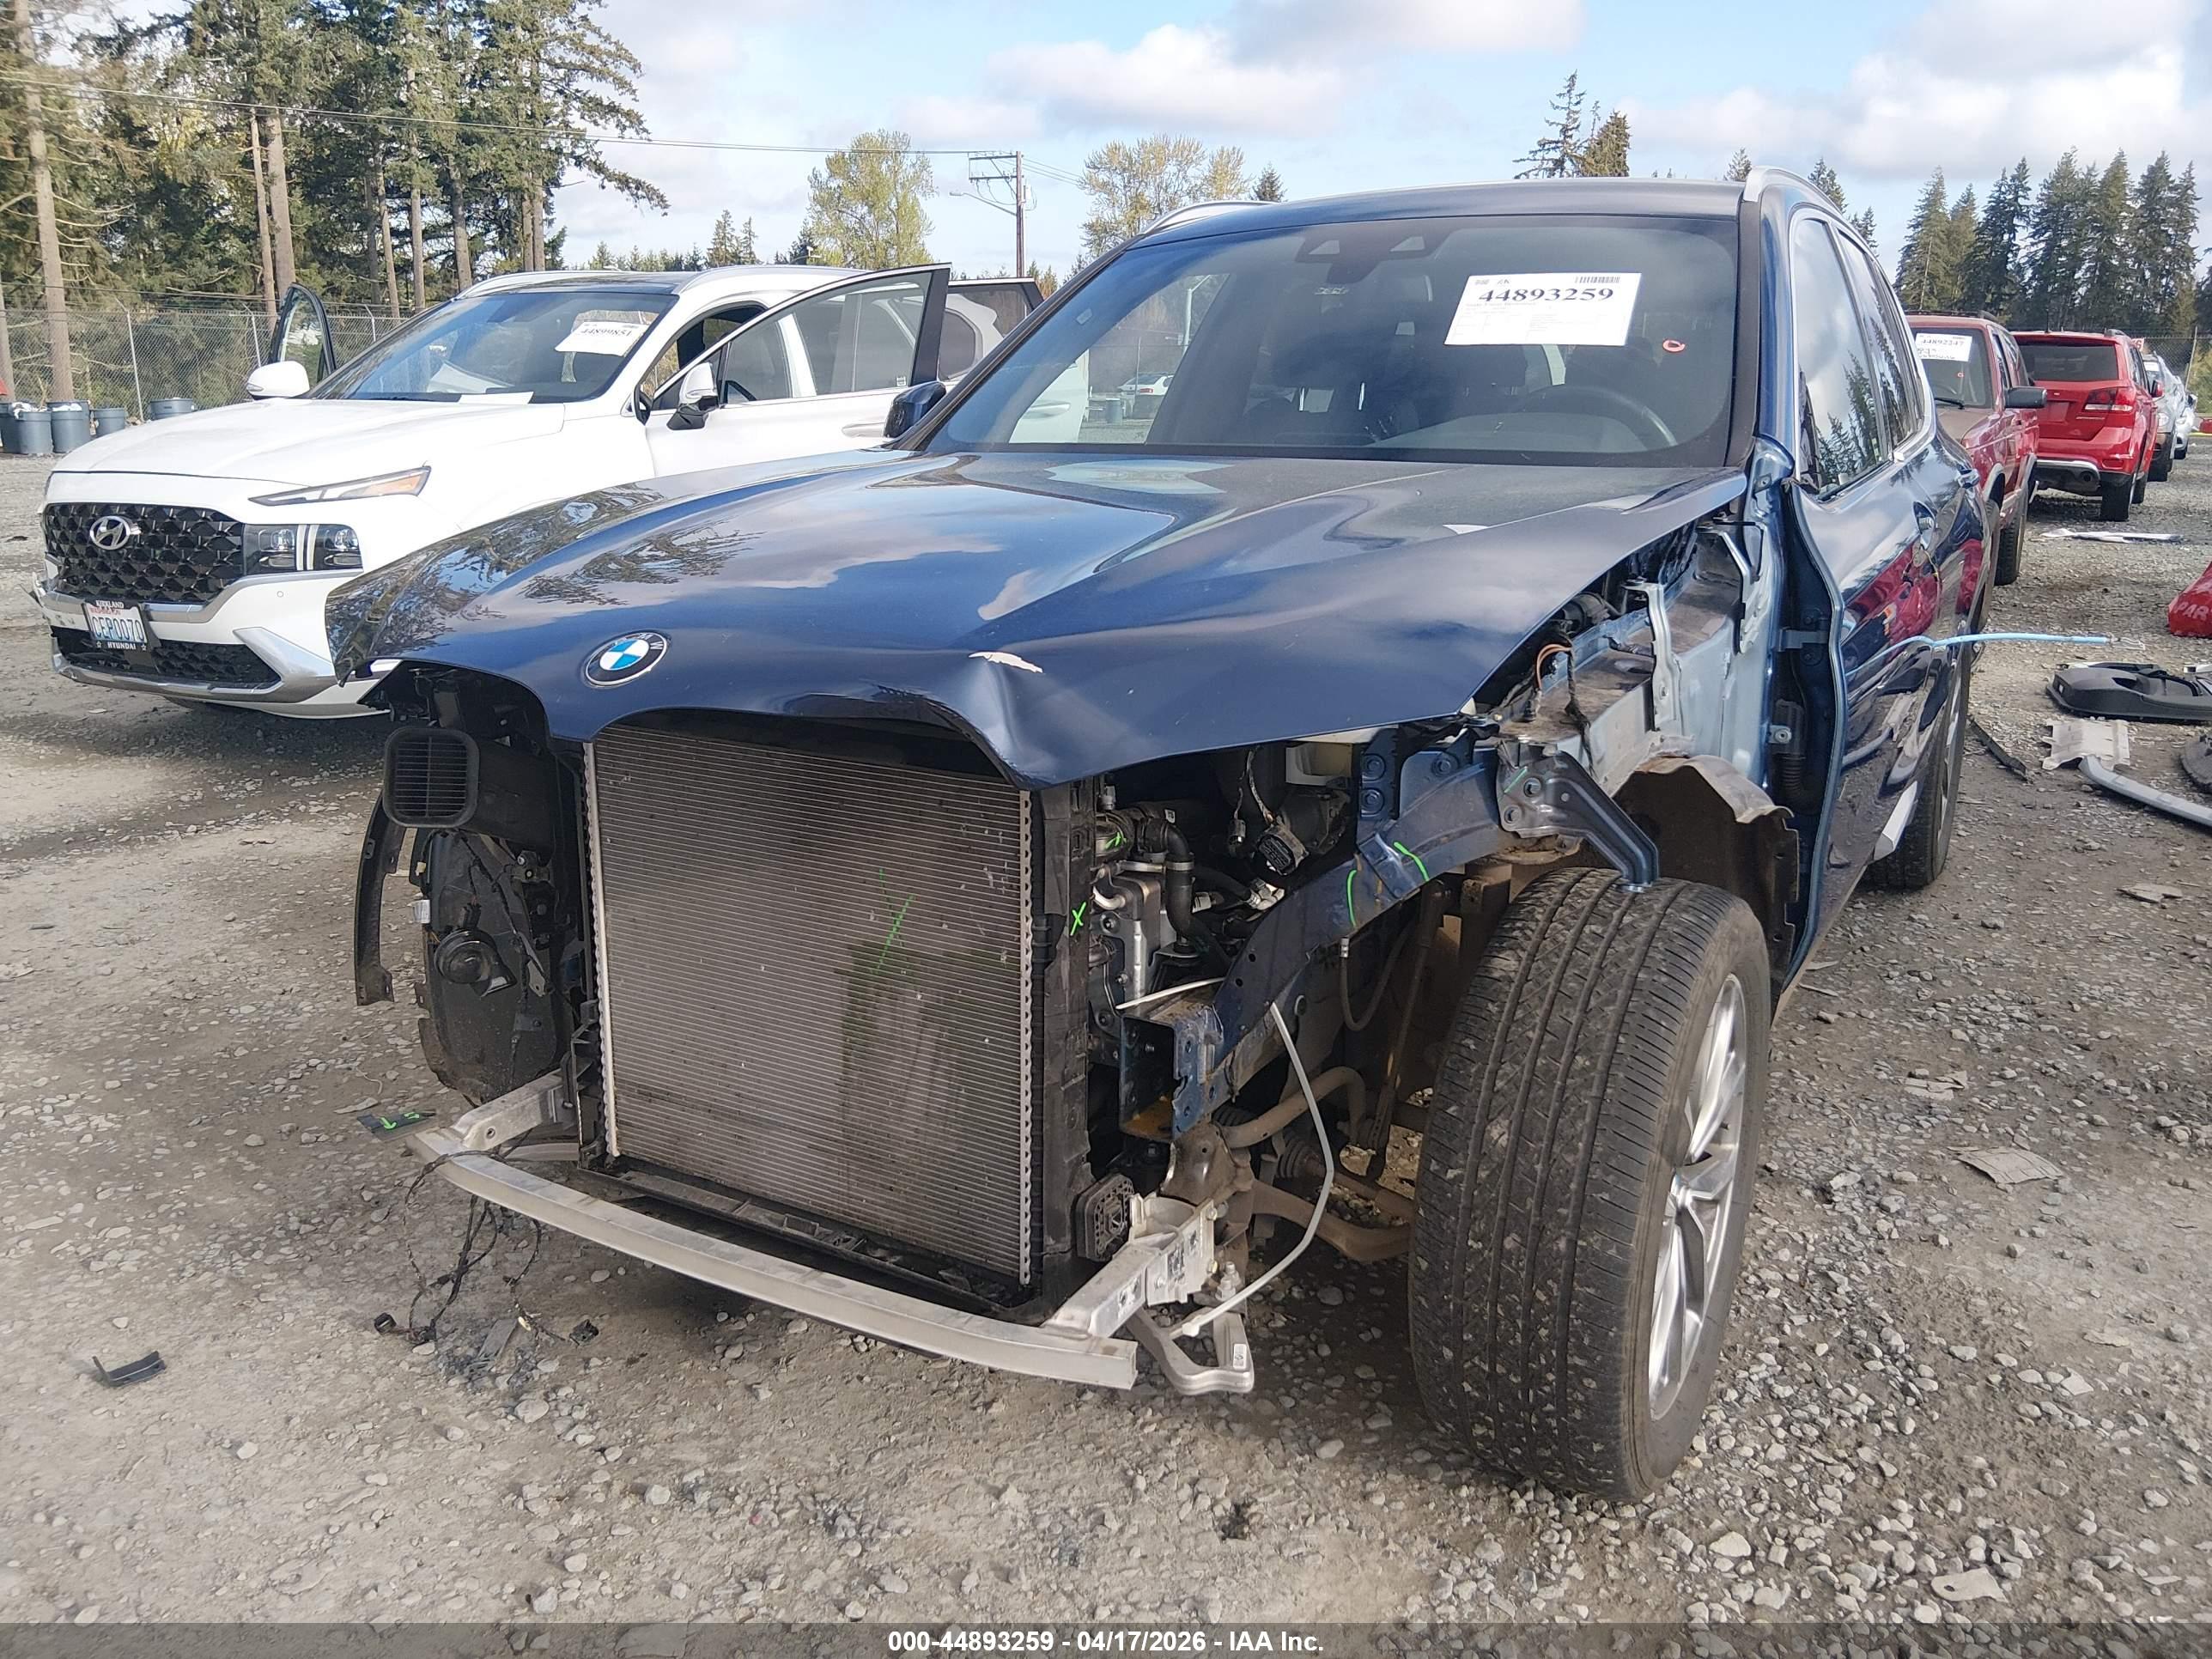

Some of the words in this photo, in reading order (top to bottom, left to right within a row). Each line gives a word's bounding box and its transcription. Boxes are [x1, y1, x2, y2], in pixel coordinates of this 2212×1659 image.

[1479, 288, 1613, 302] 44893259
[2173, 601, 2212, 621] PAR
[107, 641, 136, 650] HYUNDAI
